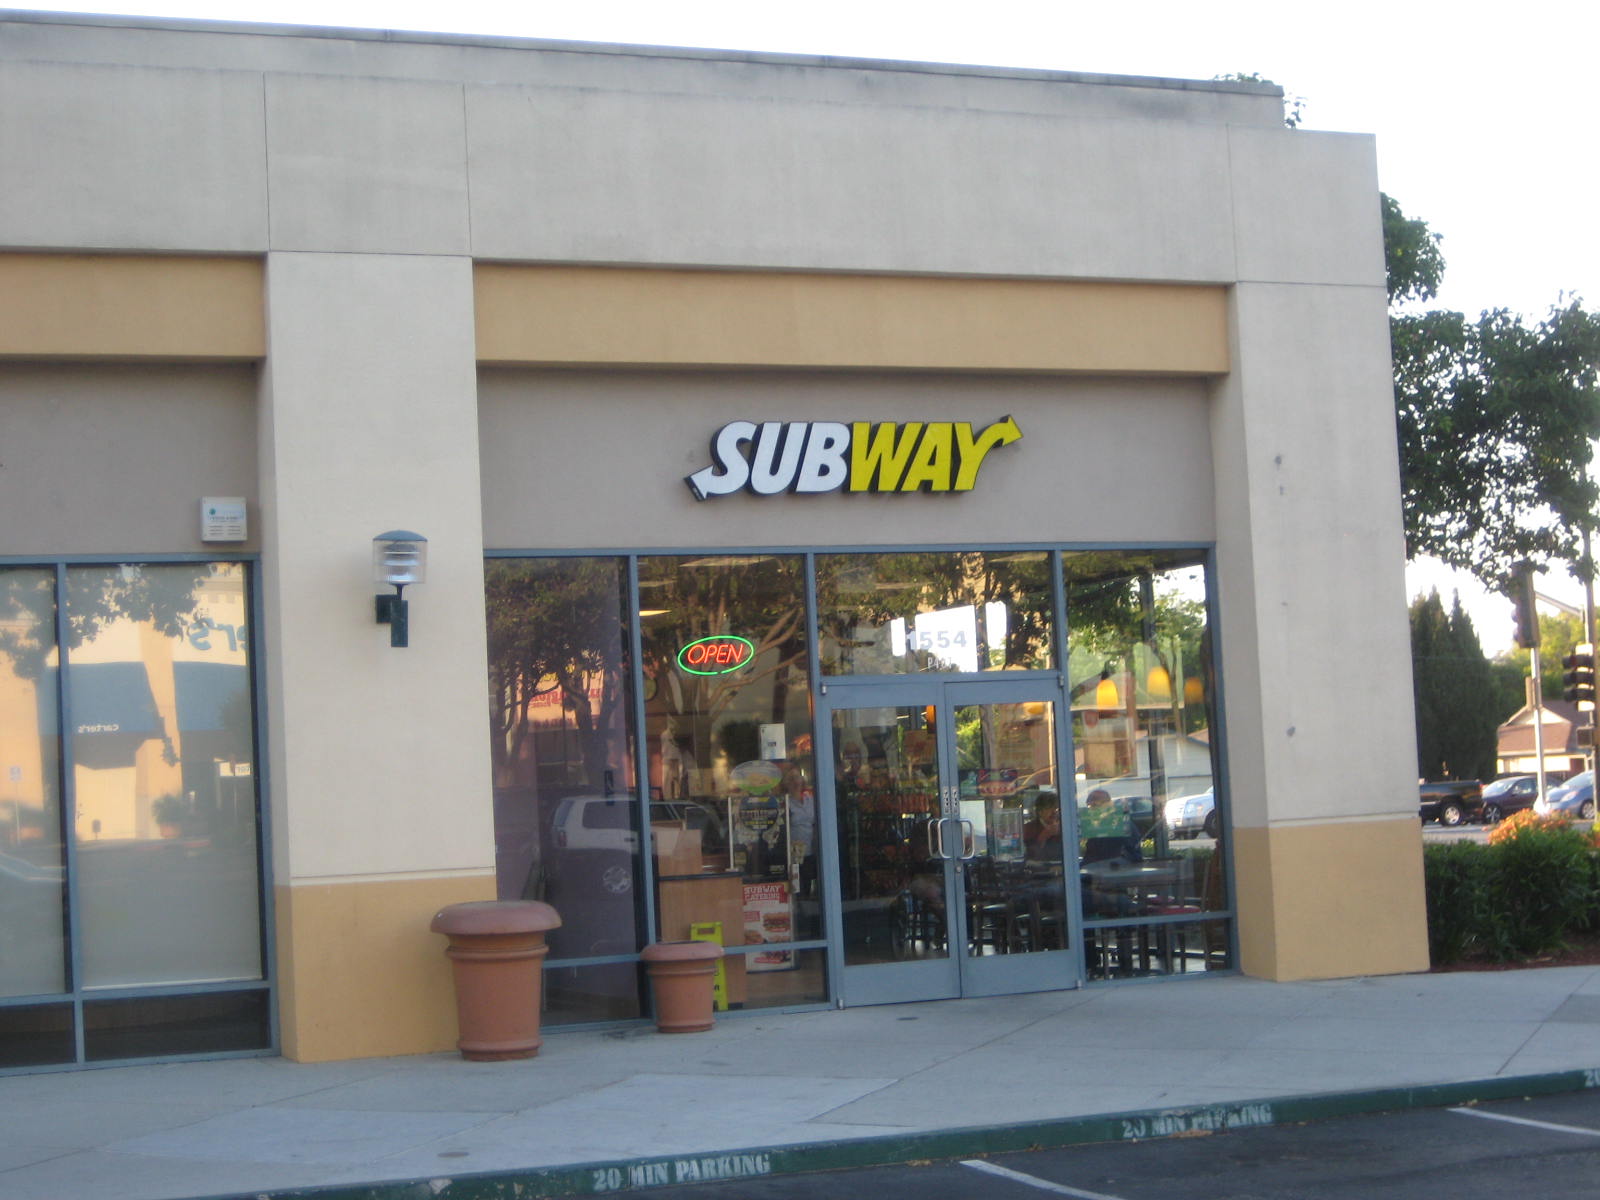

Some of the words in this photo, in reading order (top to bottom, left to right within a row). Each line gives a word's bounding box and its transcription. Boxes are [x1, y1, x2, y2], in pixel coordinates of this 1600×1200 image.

[686, 415, 1023, 499] SUBWAY
[687, 643, 744, 665] OPEN
[906, 630, 967, 651] 1554
[593, 1166, 621, 1191] 20
[628, 1161, 668, 1186] MIN
[675, 1154, 770, 1181] PARKING
